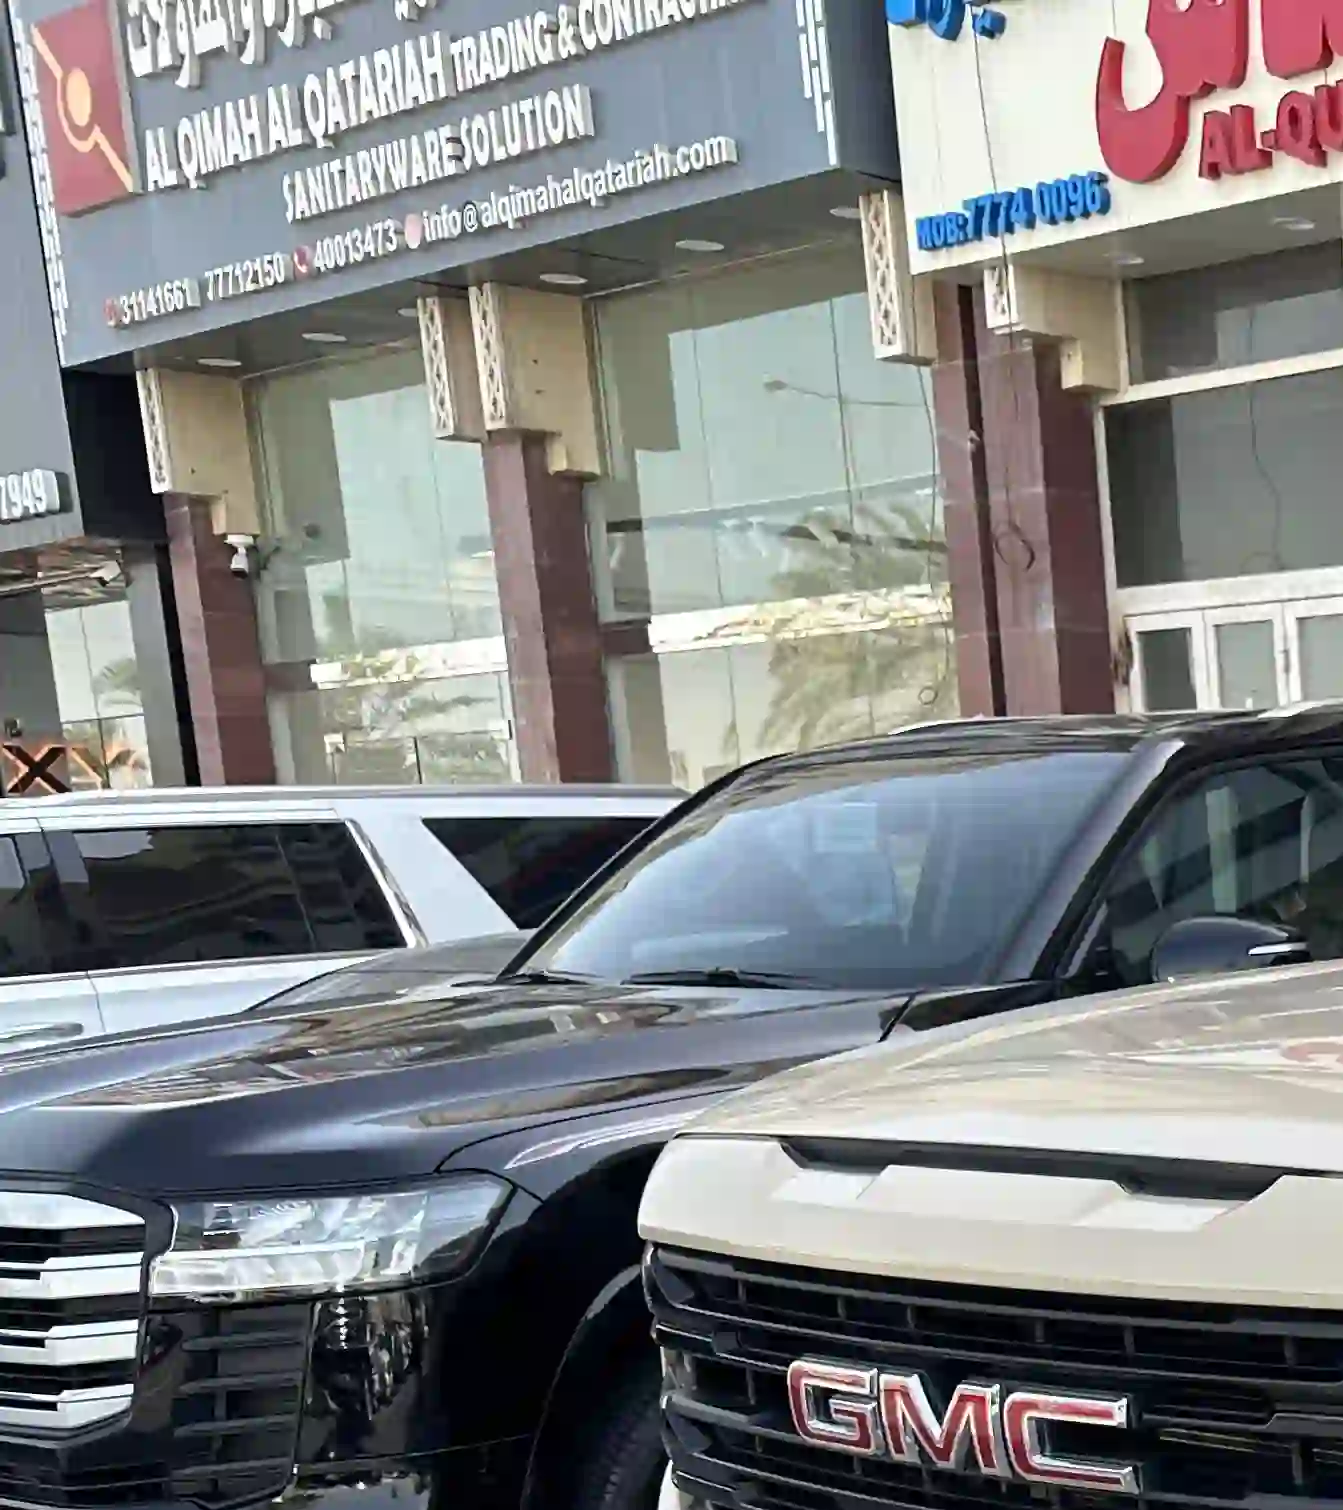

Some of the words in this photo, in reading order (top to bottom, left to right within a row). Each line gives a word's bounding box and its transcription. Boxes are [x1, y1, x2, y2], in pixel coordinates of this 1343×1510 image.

[145, 127, 179, 192] AL
[177, 94, 262, 189] QIMAH
[266, 83, 305, 151] AL
[303, 31, 449, 149] QATARIAH
[450, 10, 557, 92] TRADING
[557, 3, 578, 60] &
[282, 124, 461, 223] SANITARYWARE
[460, 84, 592, 172] SOLUTION
[118, 278, 195, 326] 31141661
[204, 251, 286, 302] 77712150
[313, 218, 398, 273] 40013473
[787, 1358, 1141, 1495] GMC
